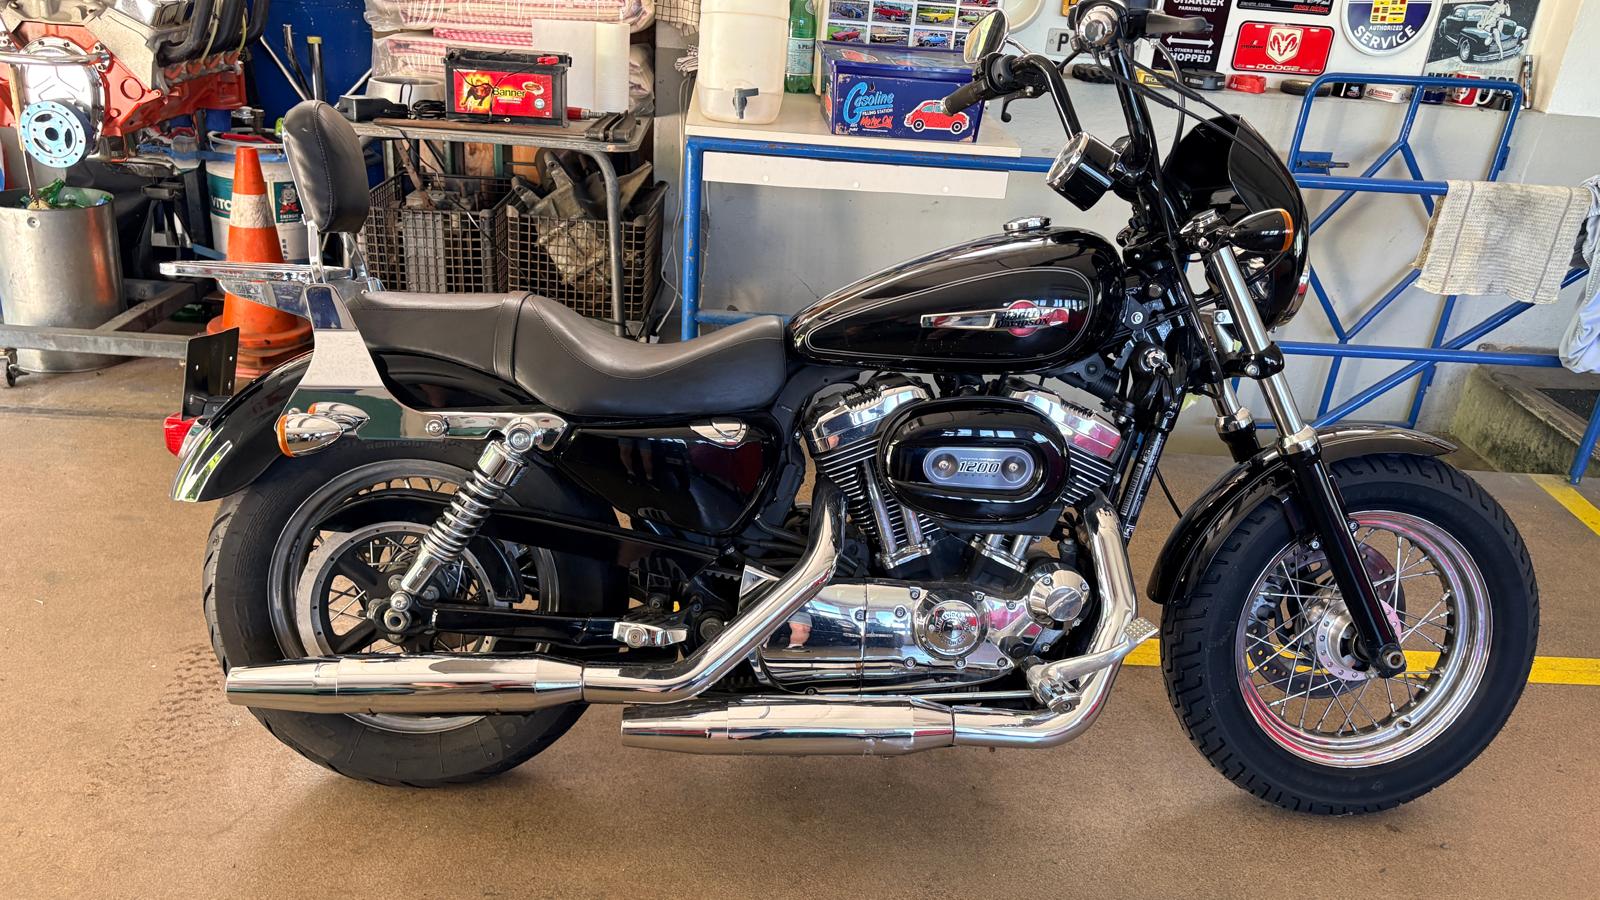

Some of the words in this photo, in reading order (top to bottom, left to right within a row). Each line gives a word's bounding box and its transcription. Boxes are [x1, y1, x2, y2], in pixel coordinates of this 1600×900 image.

[1354, 25, 1416, 49] SERVICE
[493, 87, 525, 97] Banner
[843, 82, 894, 124] Gasoline
[958, 461, 1001, 474] 1200
